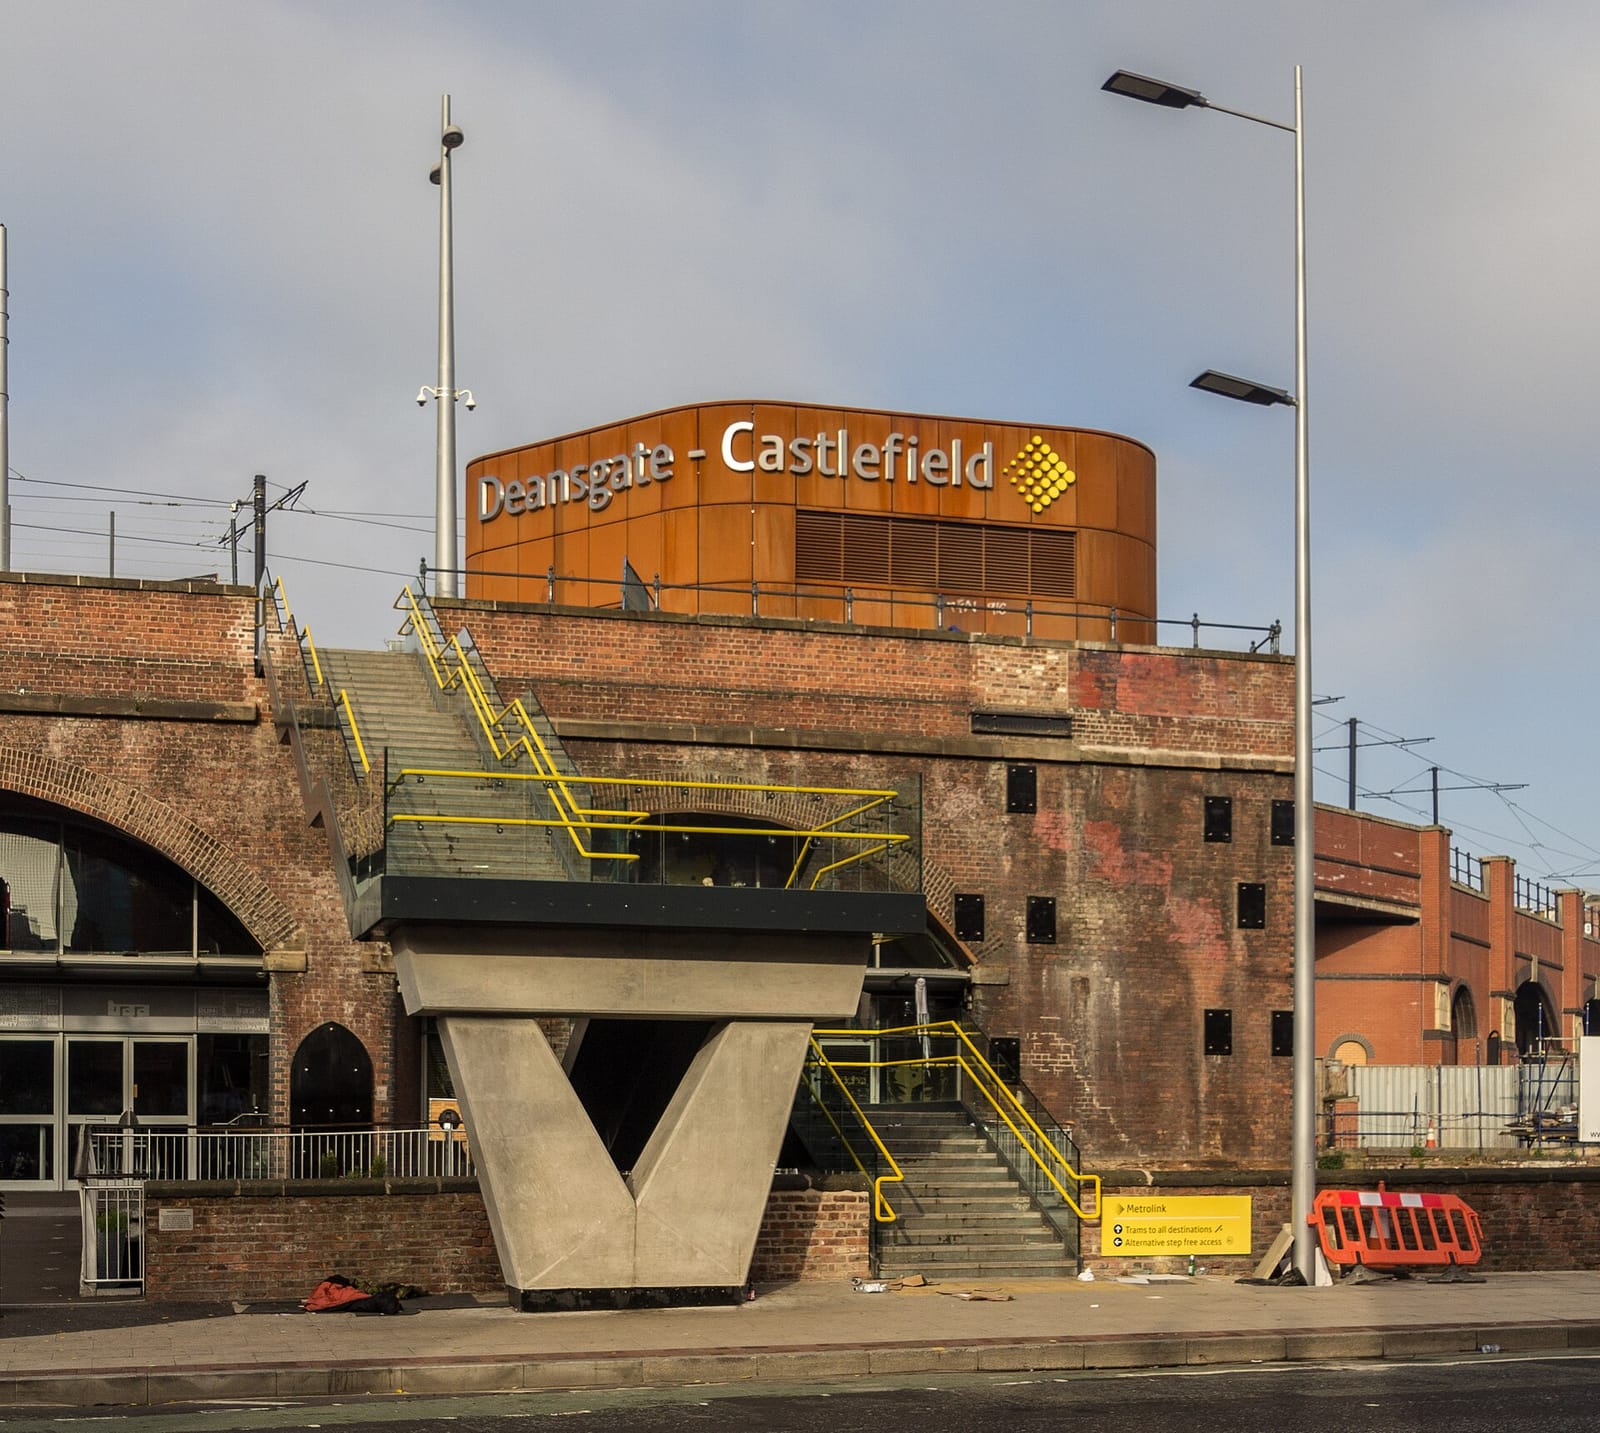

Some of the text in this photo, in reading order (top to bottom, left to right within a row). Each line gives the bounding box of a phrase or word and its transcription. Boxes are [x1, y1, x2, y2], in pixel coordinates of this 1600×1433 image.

[478, 421, 993, 522] Deansgate - Castlefield
[1126, 1203, 1167, 1213] Metrolink
[1126, 1225, 1212, 1234] Trams to all destinations
[1126, 1238, 1165, 1247] Alternative
[1167, 1239, 1182, 1248] step
[1183, 1238, 1198, 1246] free
